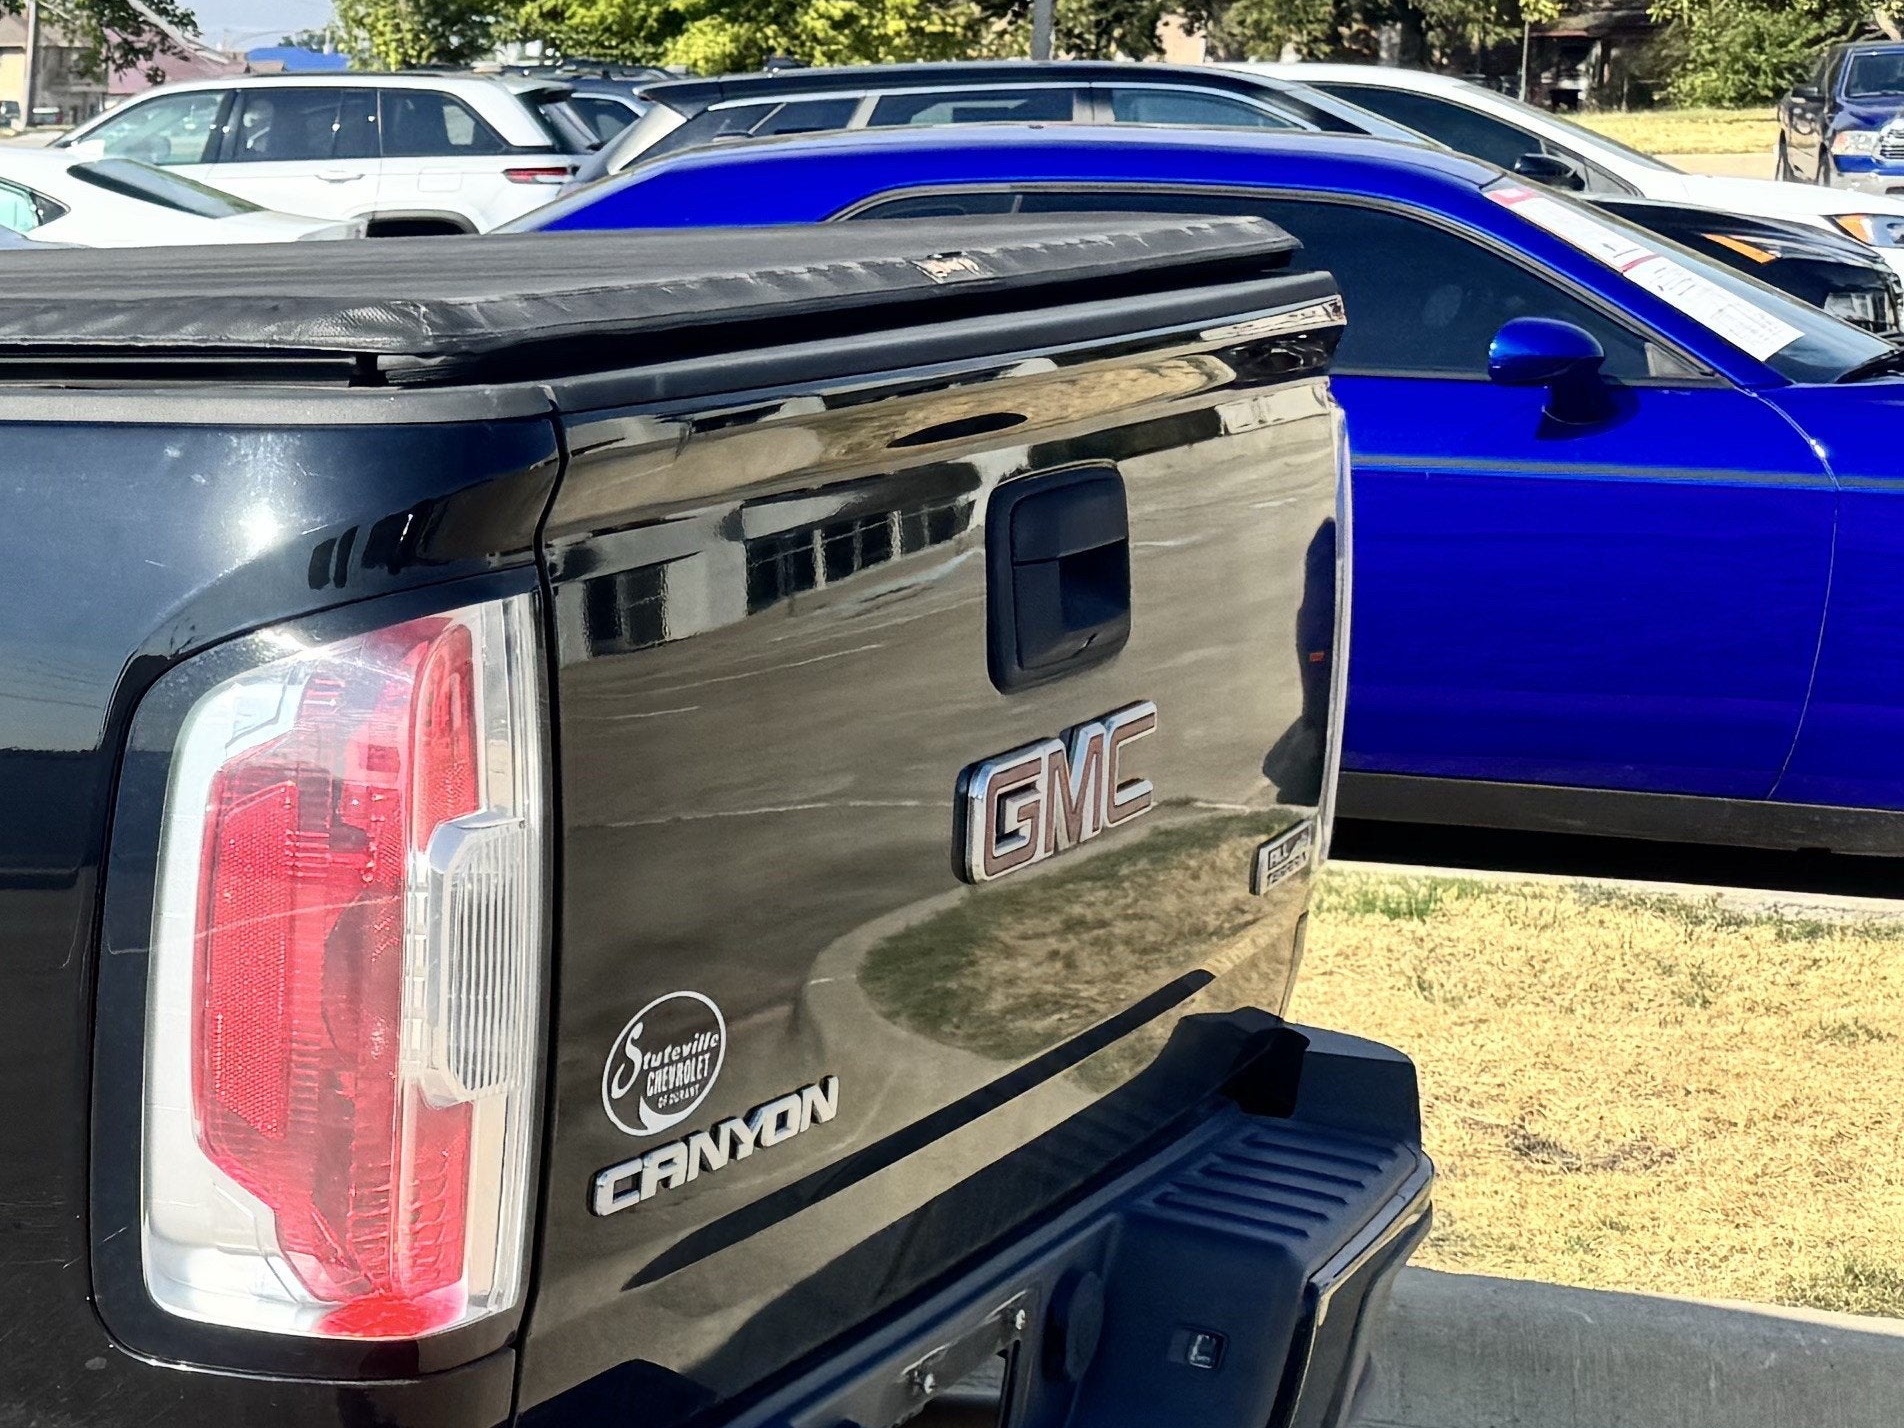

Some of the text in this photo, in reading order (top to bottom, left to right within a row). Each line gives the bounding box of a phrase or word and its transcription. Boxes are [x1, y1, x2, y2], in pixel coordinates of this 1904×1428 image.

[956, 699, 1158, 885] GMC
[590, 1075, 840, 1217] CANYON
[646, 1052, 712, 1098] CHEVROLET
